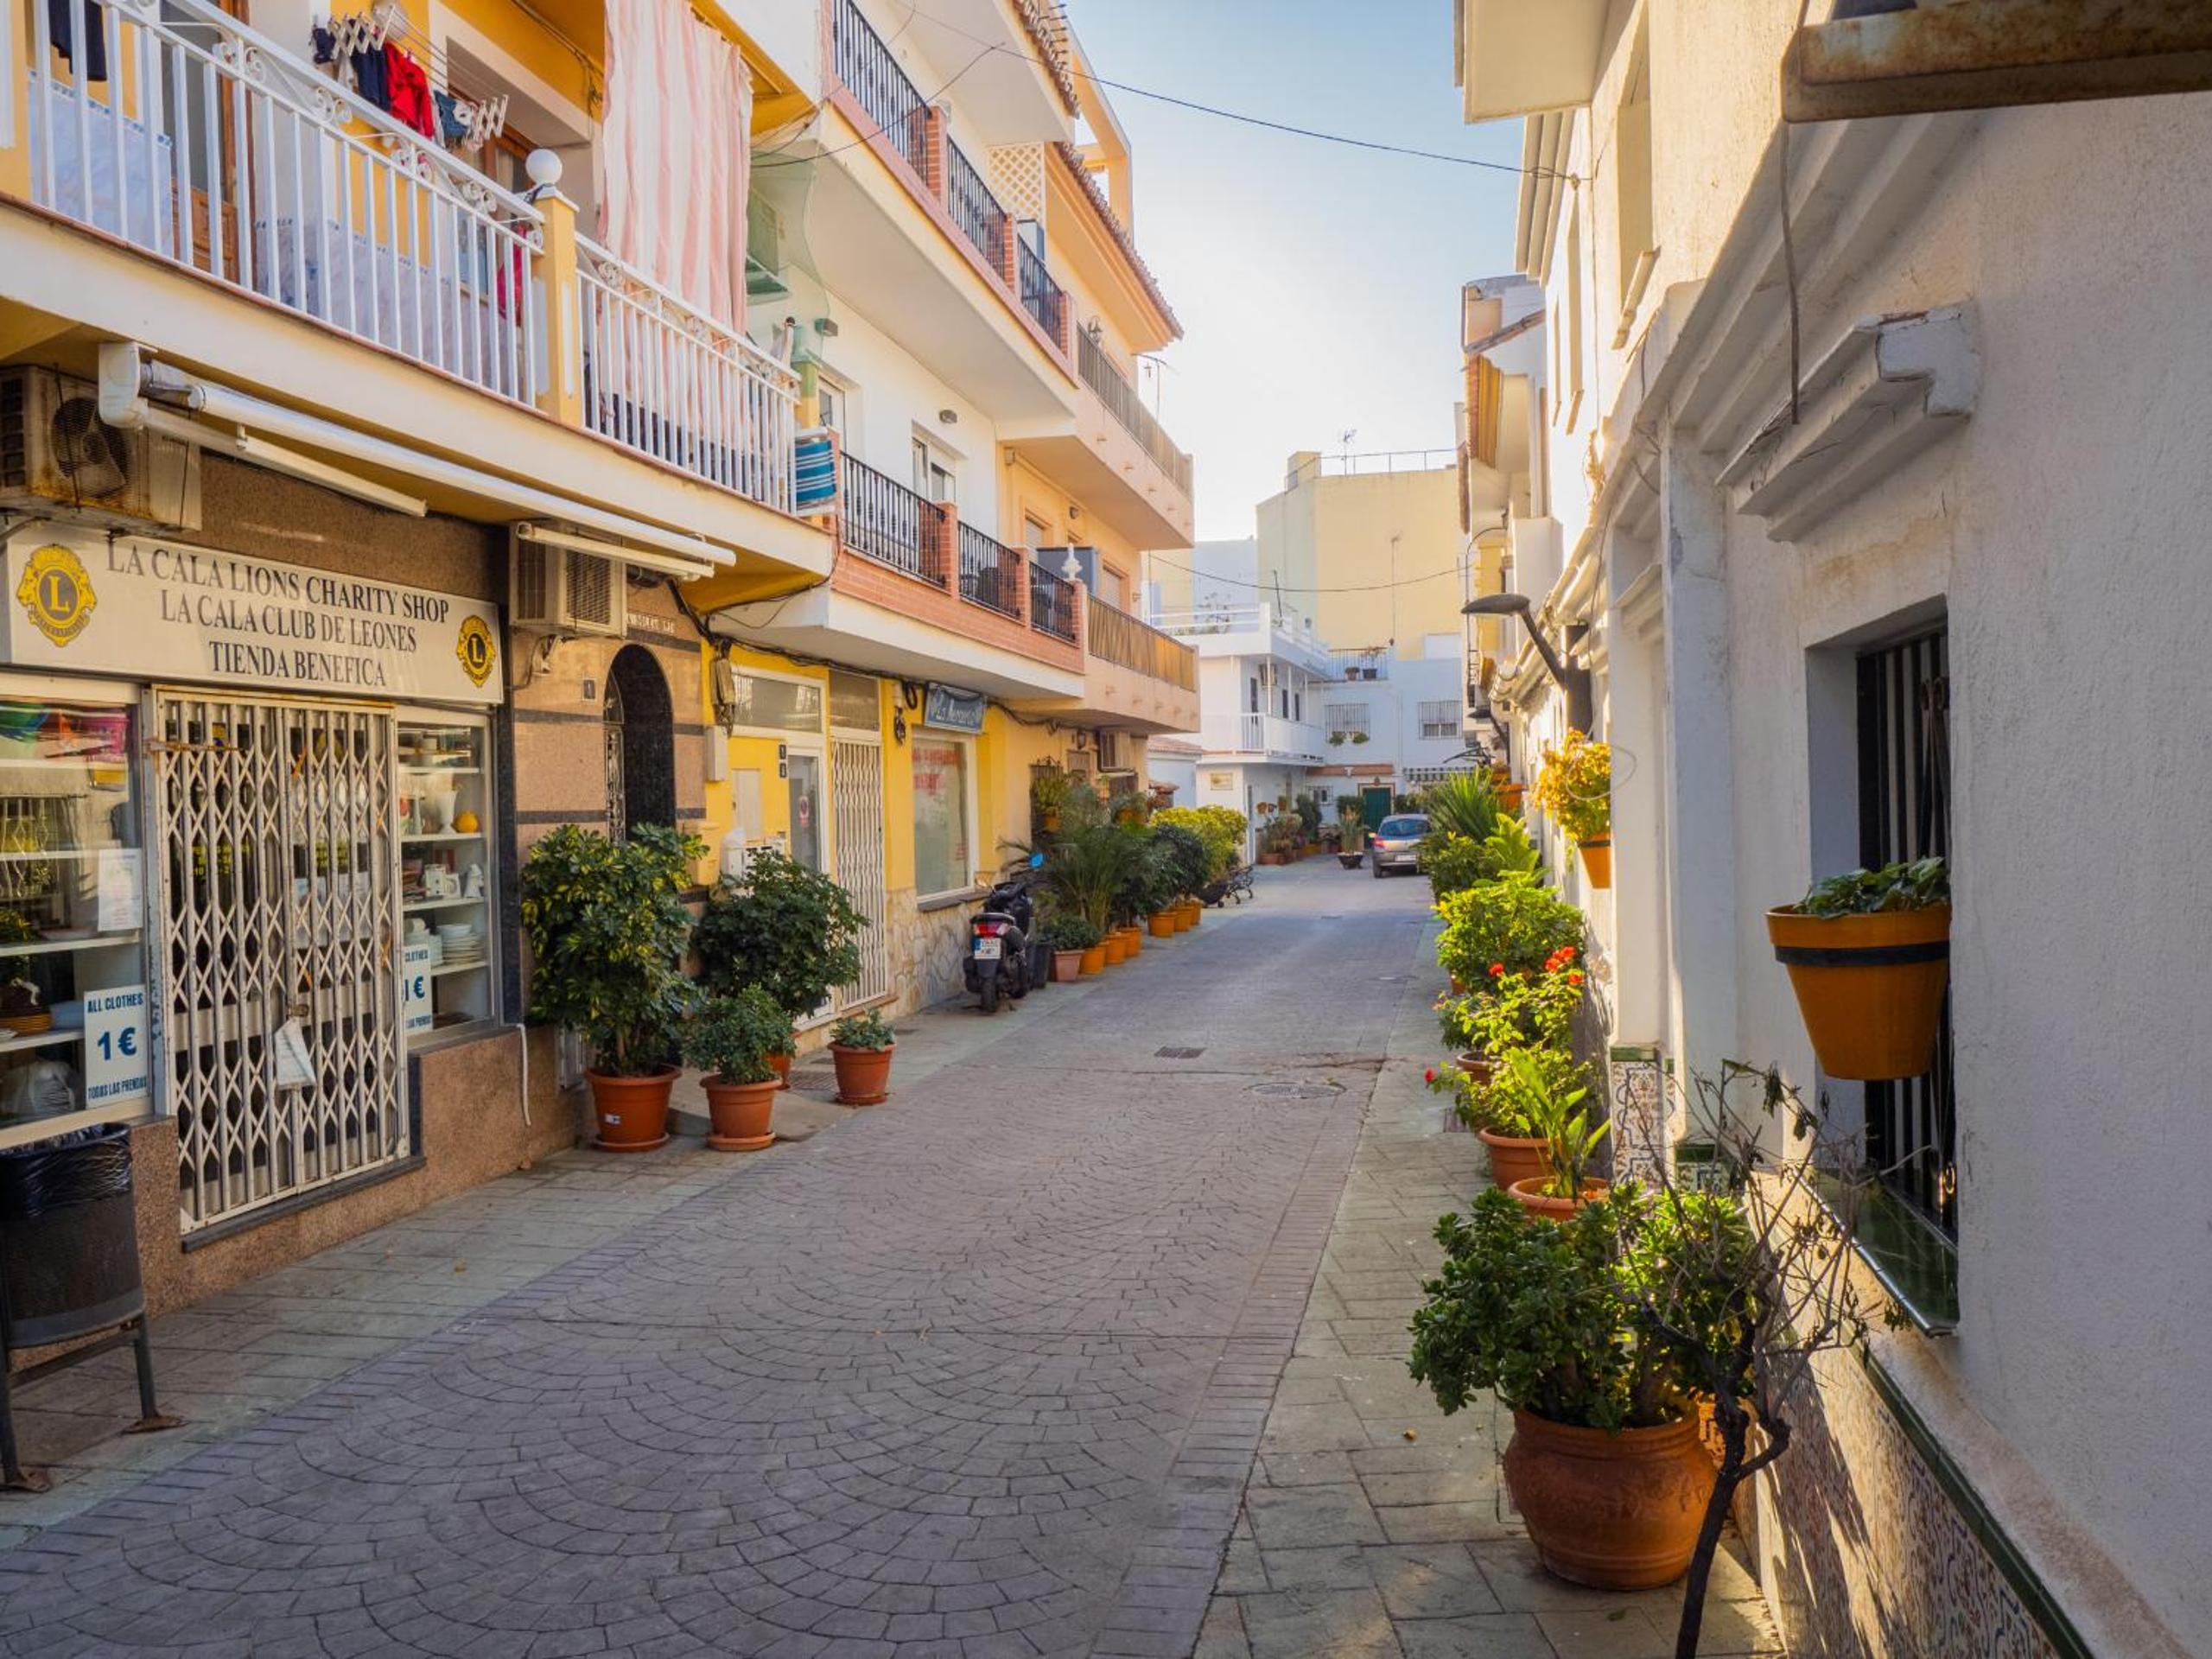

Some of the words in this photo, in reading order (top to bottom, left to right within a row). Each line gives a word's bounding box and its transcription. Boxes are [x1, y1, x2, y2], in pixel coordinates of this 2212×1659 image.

[48, 575, 69, 613] L
[107, 542, 144, 576] LA
[152, 549, 224, 589] CALA
[228, 563, 301, 601] LIONS
[307, 576, 397, 616] CHARITY
[402, 593, 449, 623] SHOP
[162, 589, 193, 624] LA
[198, 595, 258, 632] CALA
[263, 605, 315, 640] CLUB
[321, 613, 346, 644] DE
[351, 618, 416, 653] LEONES
[209, 640, 290, 678] TIENDA
[295, 650, 386, 687] BENEFICA
[471, 637, 483, 664] L
[87, 999, 103, 1014] ALL
[105, 993, 144, 1010] CLOTHES
[109, 1081, 120, 1096] LAS
